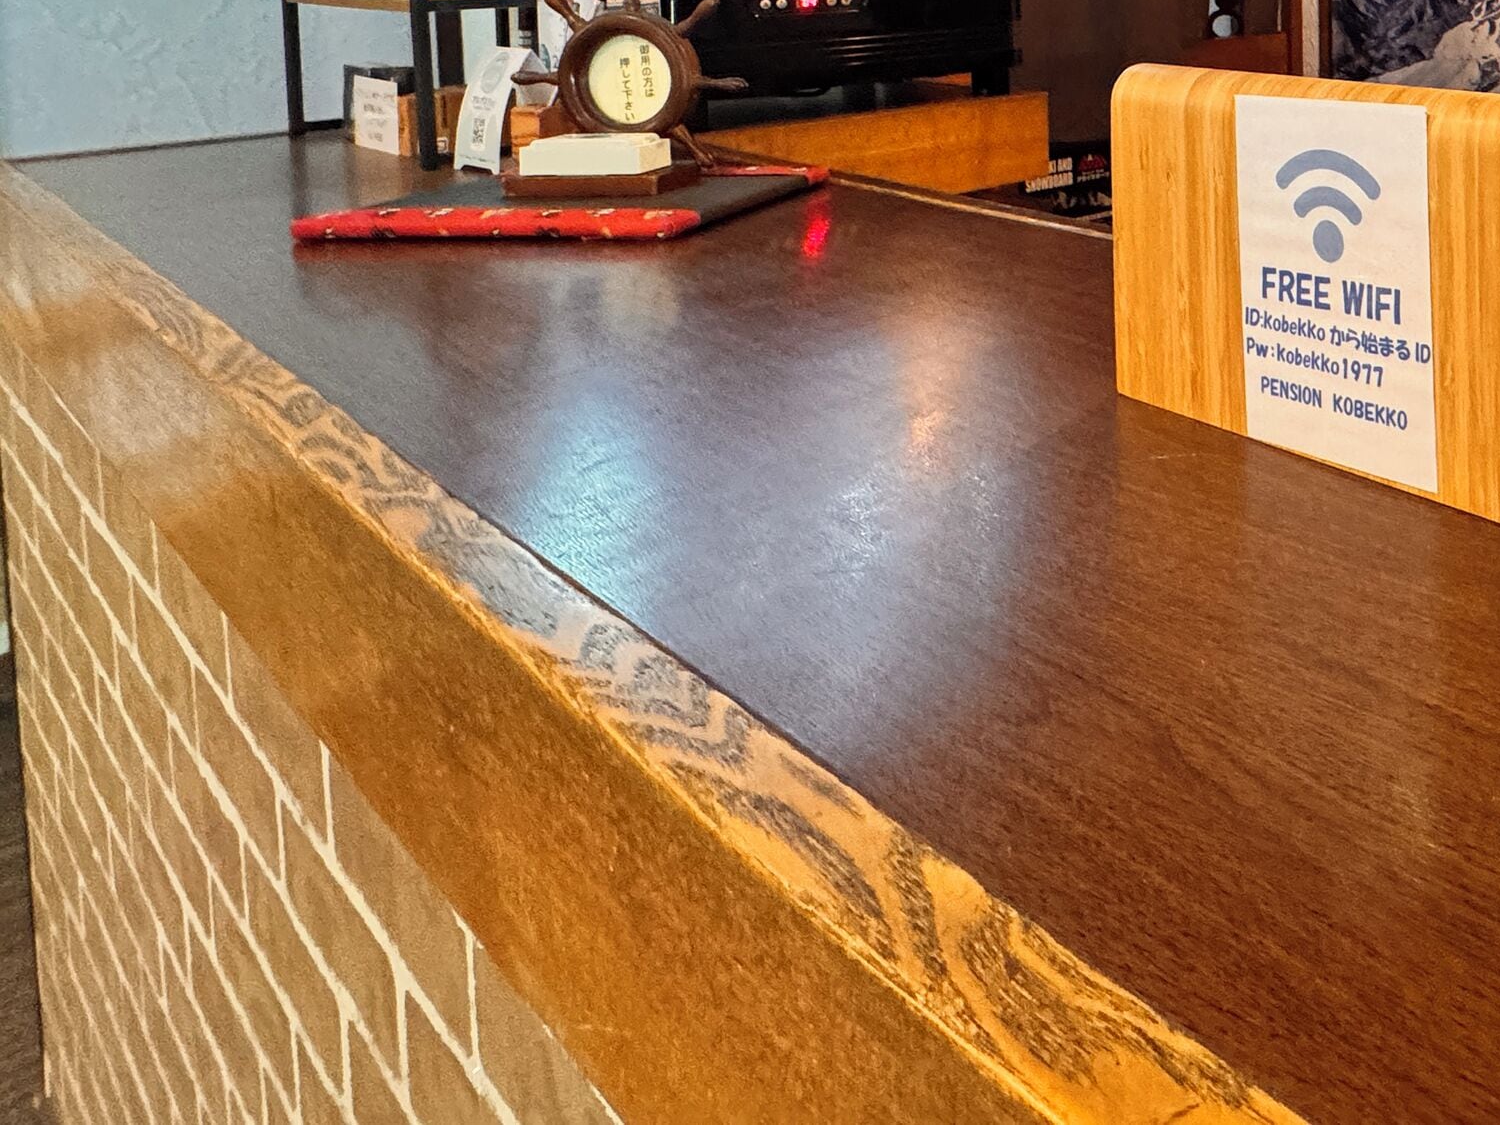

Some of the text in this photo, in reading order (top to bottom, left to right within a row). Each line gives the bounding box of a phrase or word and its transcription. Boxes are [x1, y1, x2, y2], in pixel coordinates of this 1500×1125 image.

[620, 57, 636, 121] 押して下さい
[640, 44, 656, 98] 御用の方は
[1261, 266, 1401, 325] FREE WIFI
[1261, 376, 1408, 431] PENSION KOBEKKO
